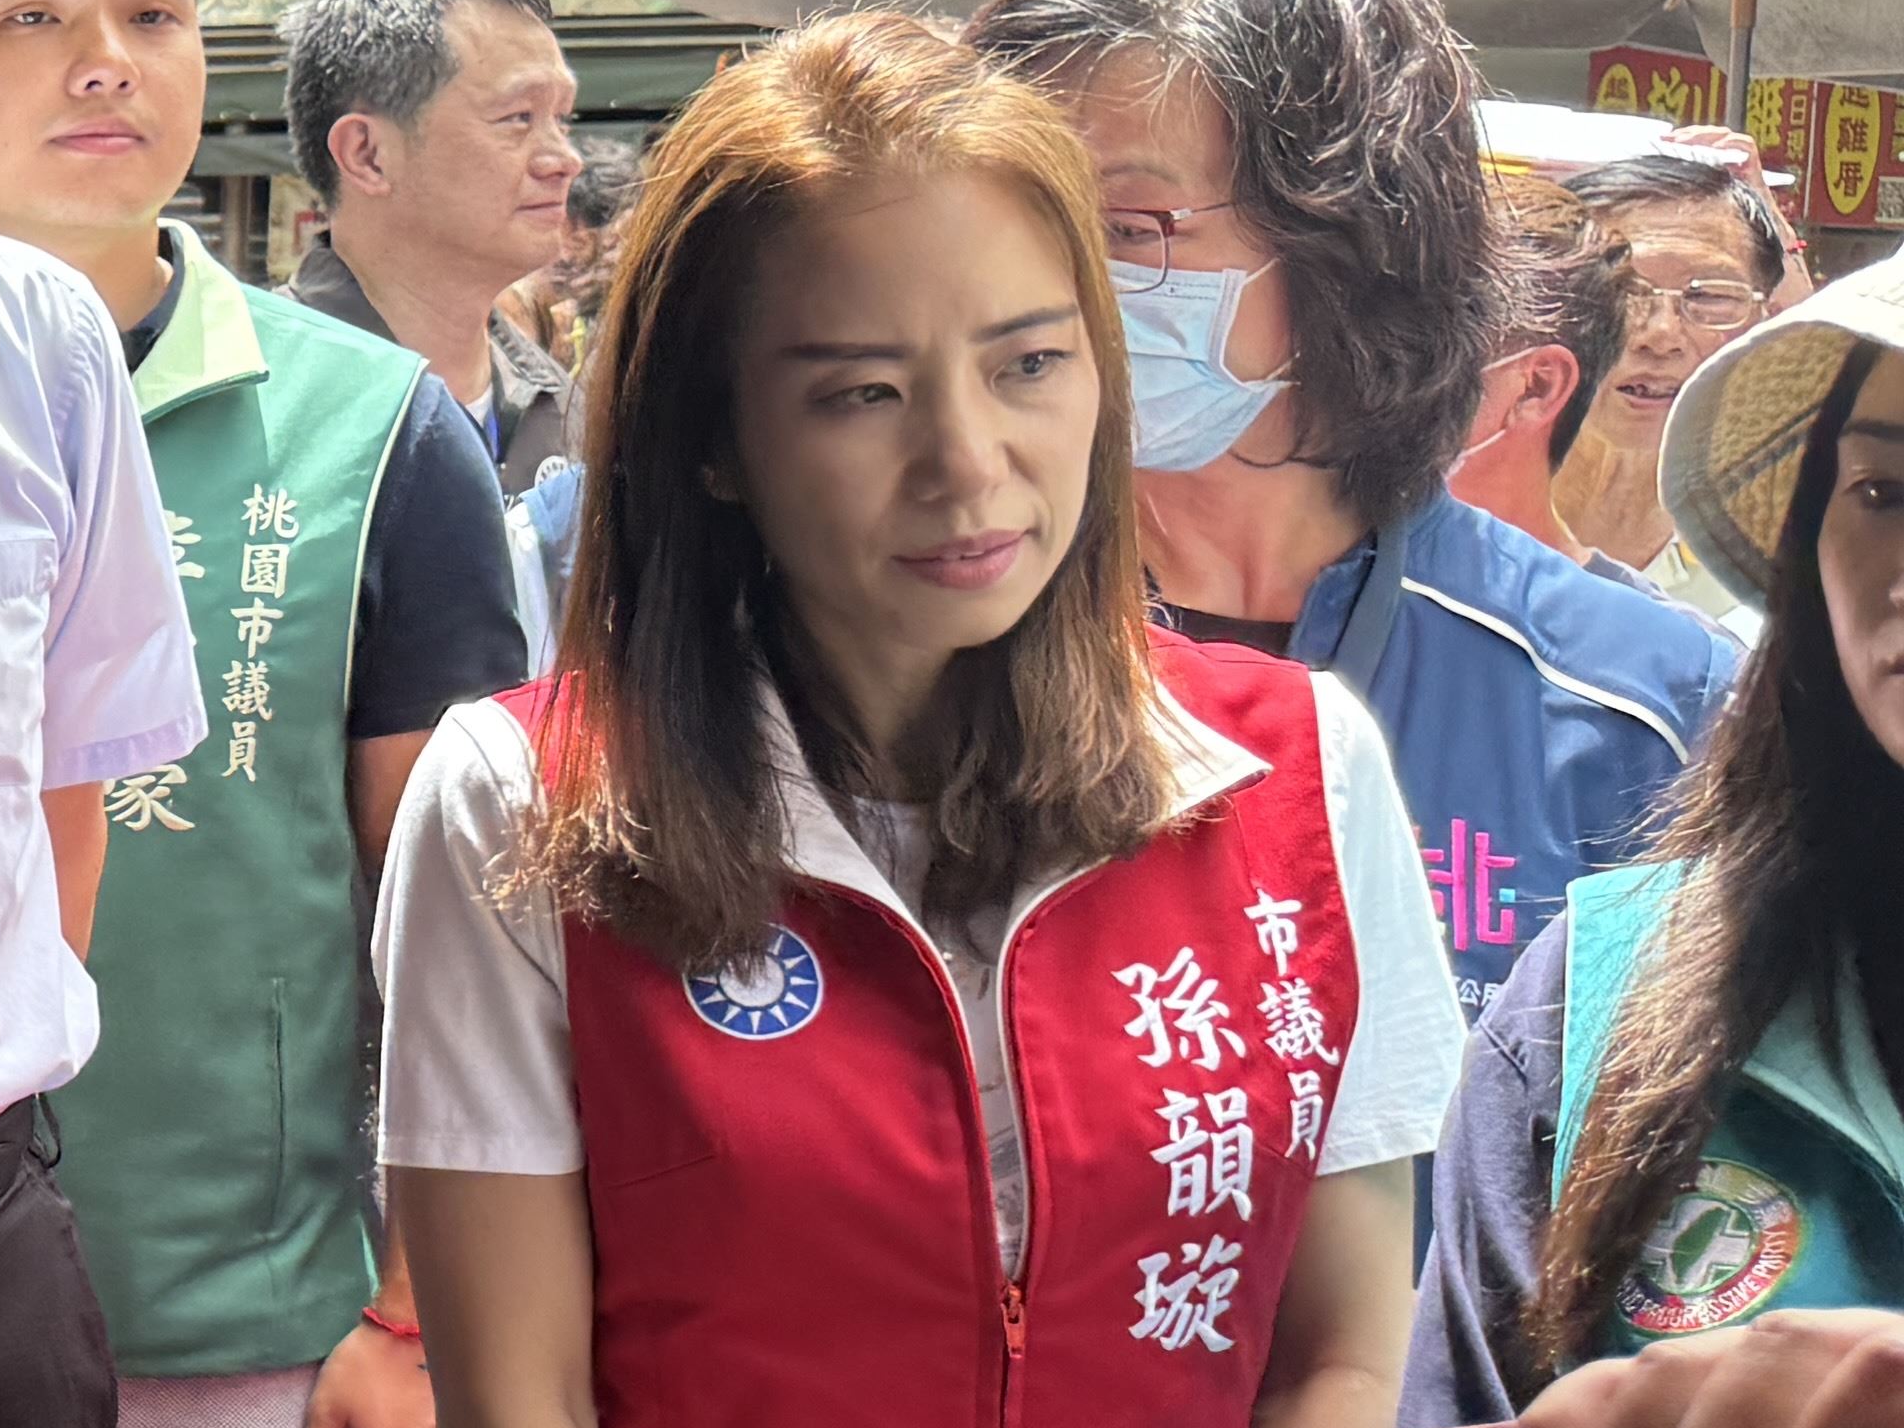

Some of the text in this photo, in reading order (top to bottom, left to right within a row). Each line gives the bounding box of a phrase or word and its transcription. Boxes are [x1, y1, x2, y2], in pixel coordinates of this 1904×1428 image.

[213, 483, 300, 783] 桃園市議員
[1110, 945, 1256, 1353] 孫韻璇
[1244, 887, 1340, 1161] 市議員
